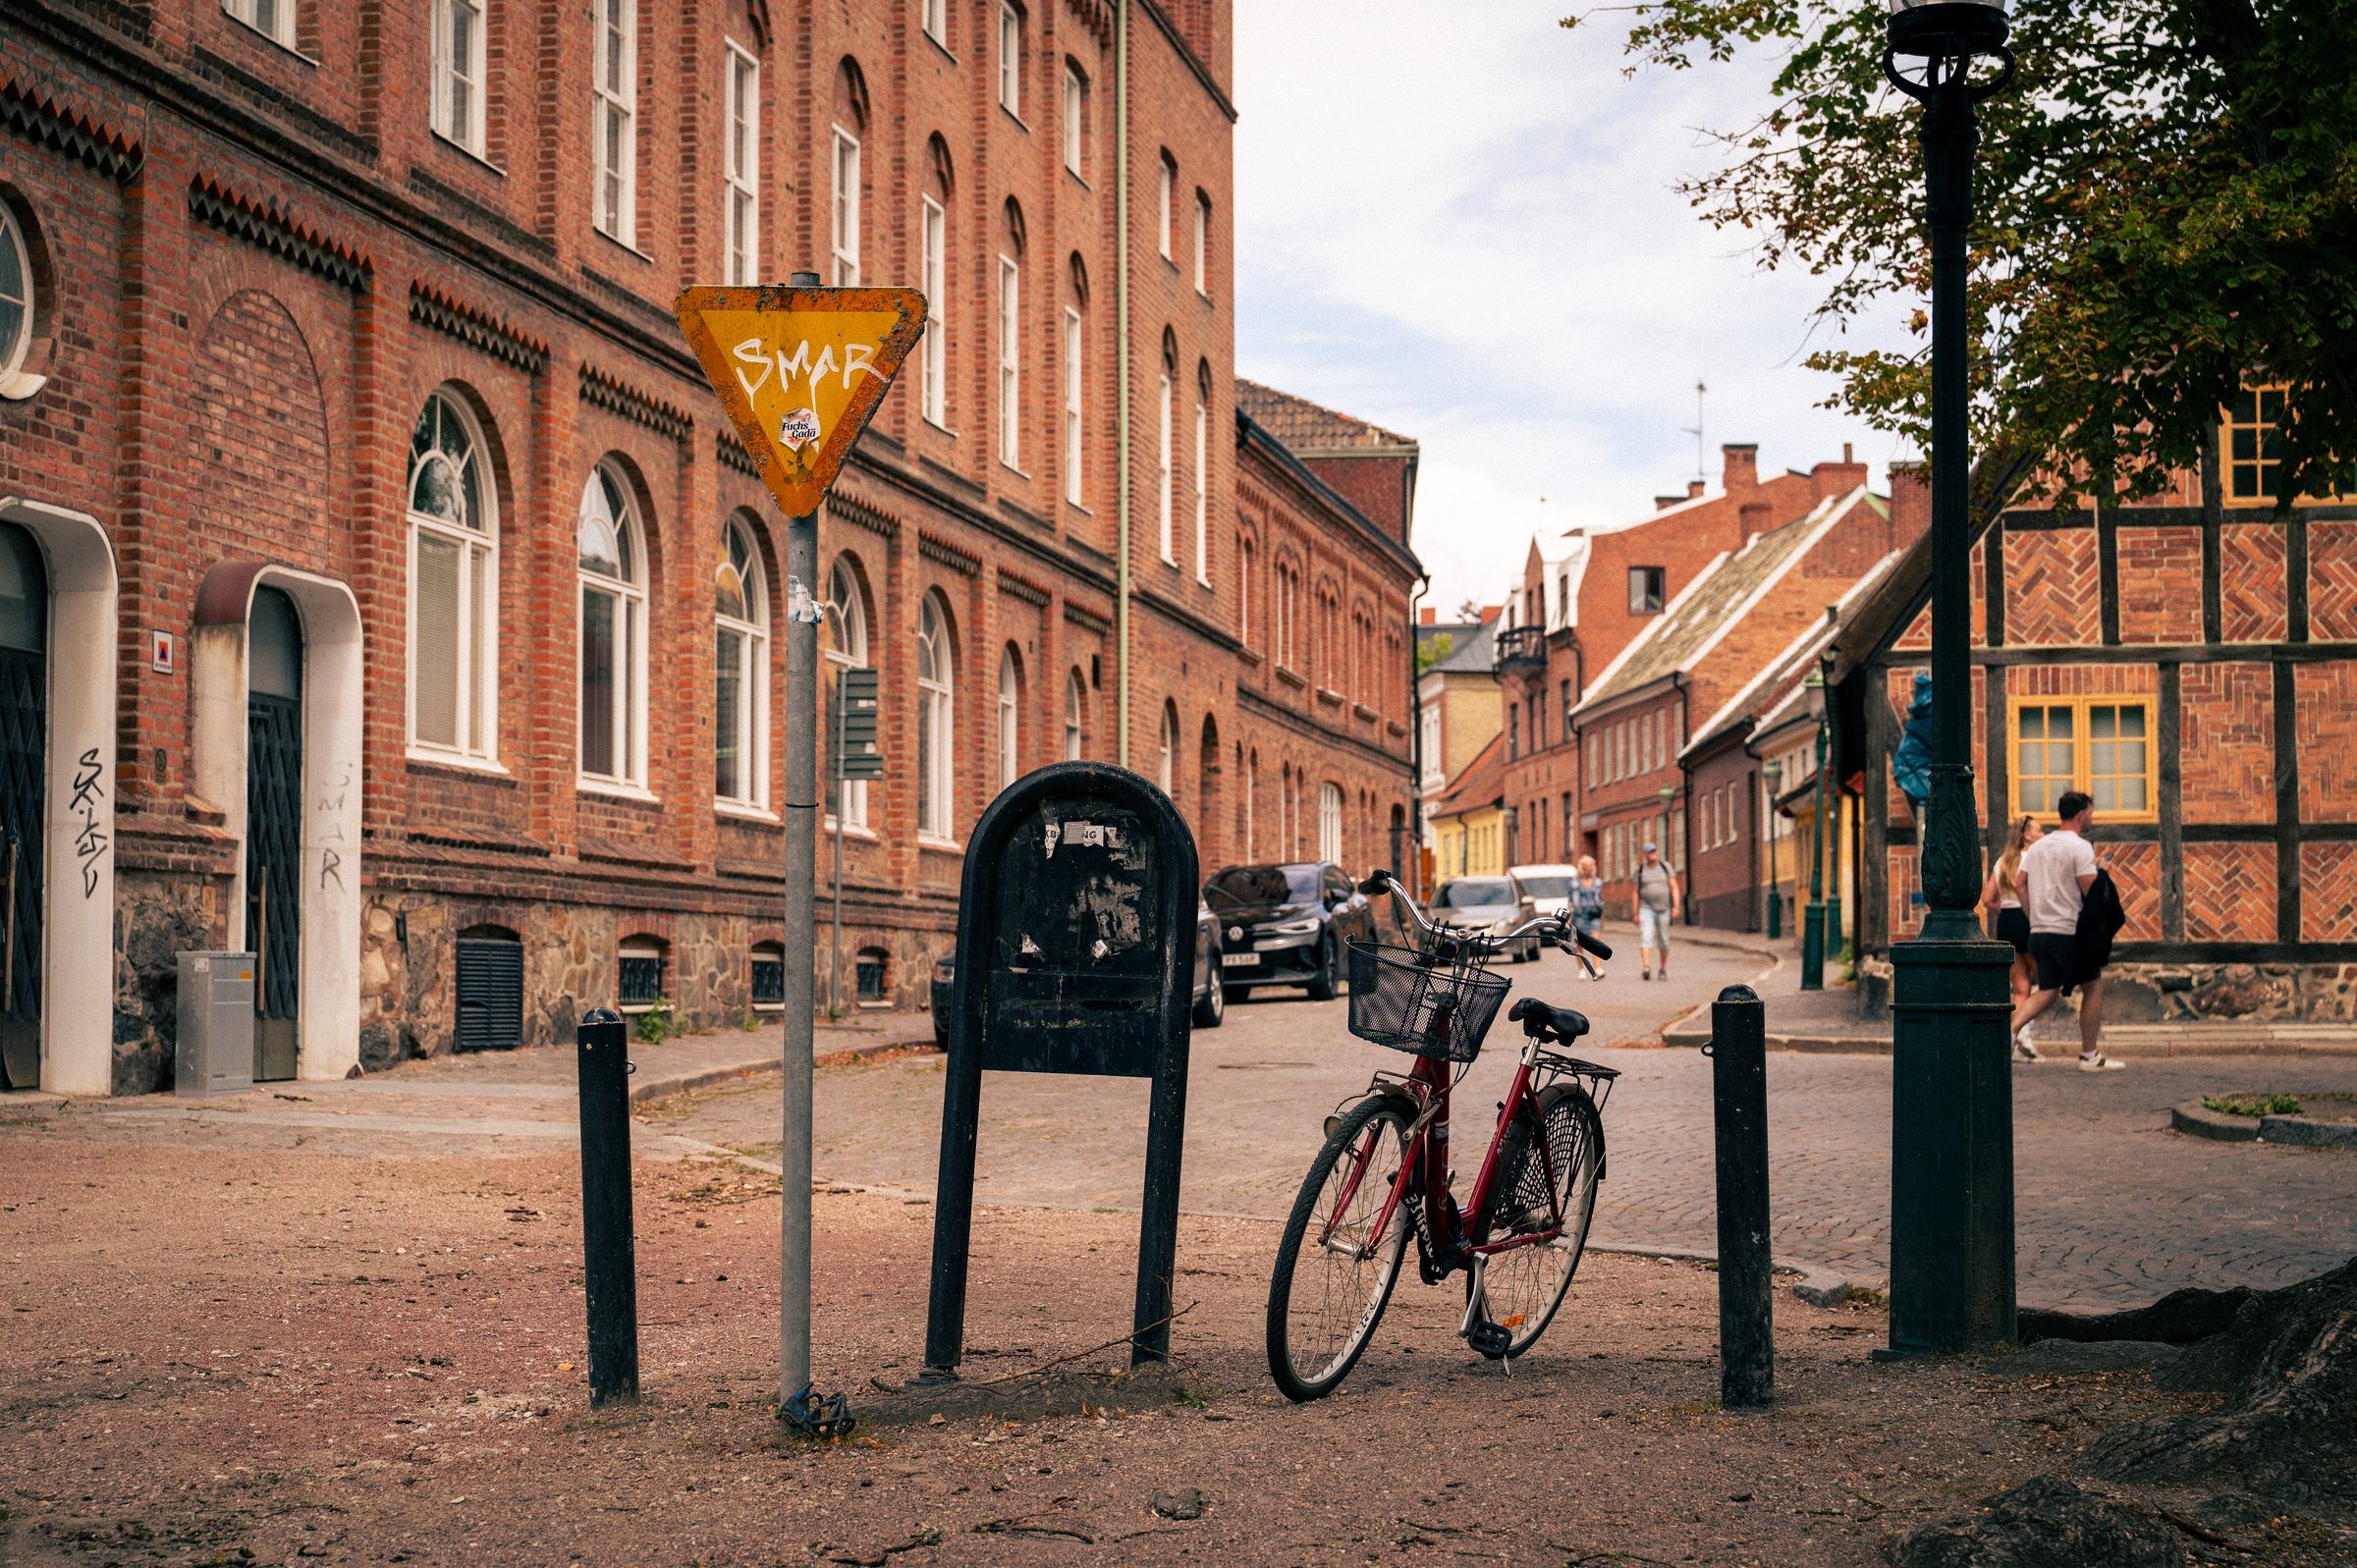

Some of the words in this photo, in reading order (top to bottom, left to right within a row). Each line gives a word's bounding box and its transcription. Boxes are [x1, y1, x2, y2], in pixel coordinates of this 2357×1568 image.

[733, 338, 890, 399] SMAR
[782, 421, 809, 431] Fuchs
[792, 428, 816, 440] Gadä
